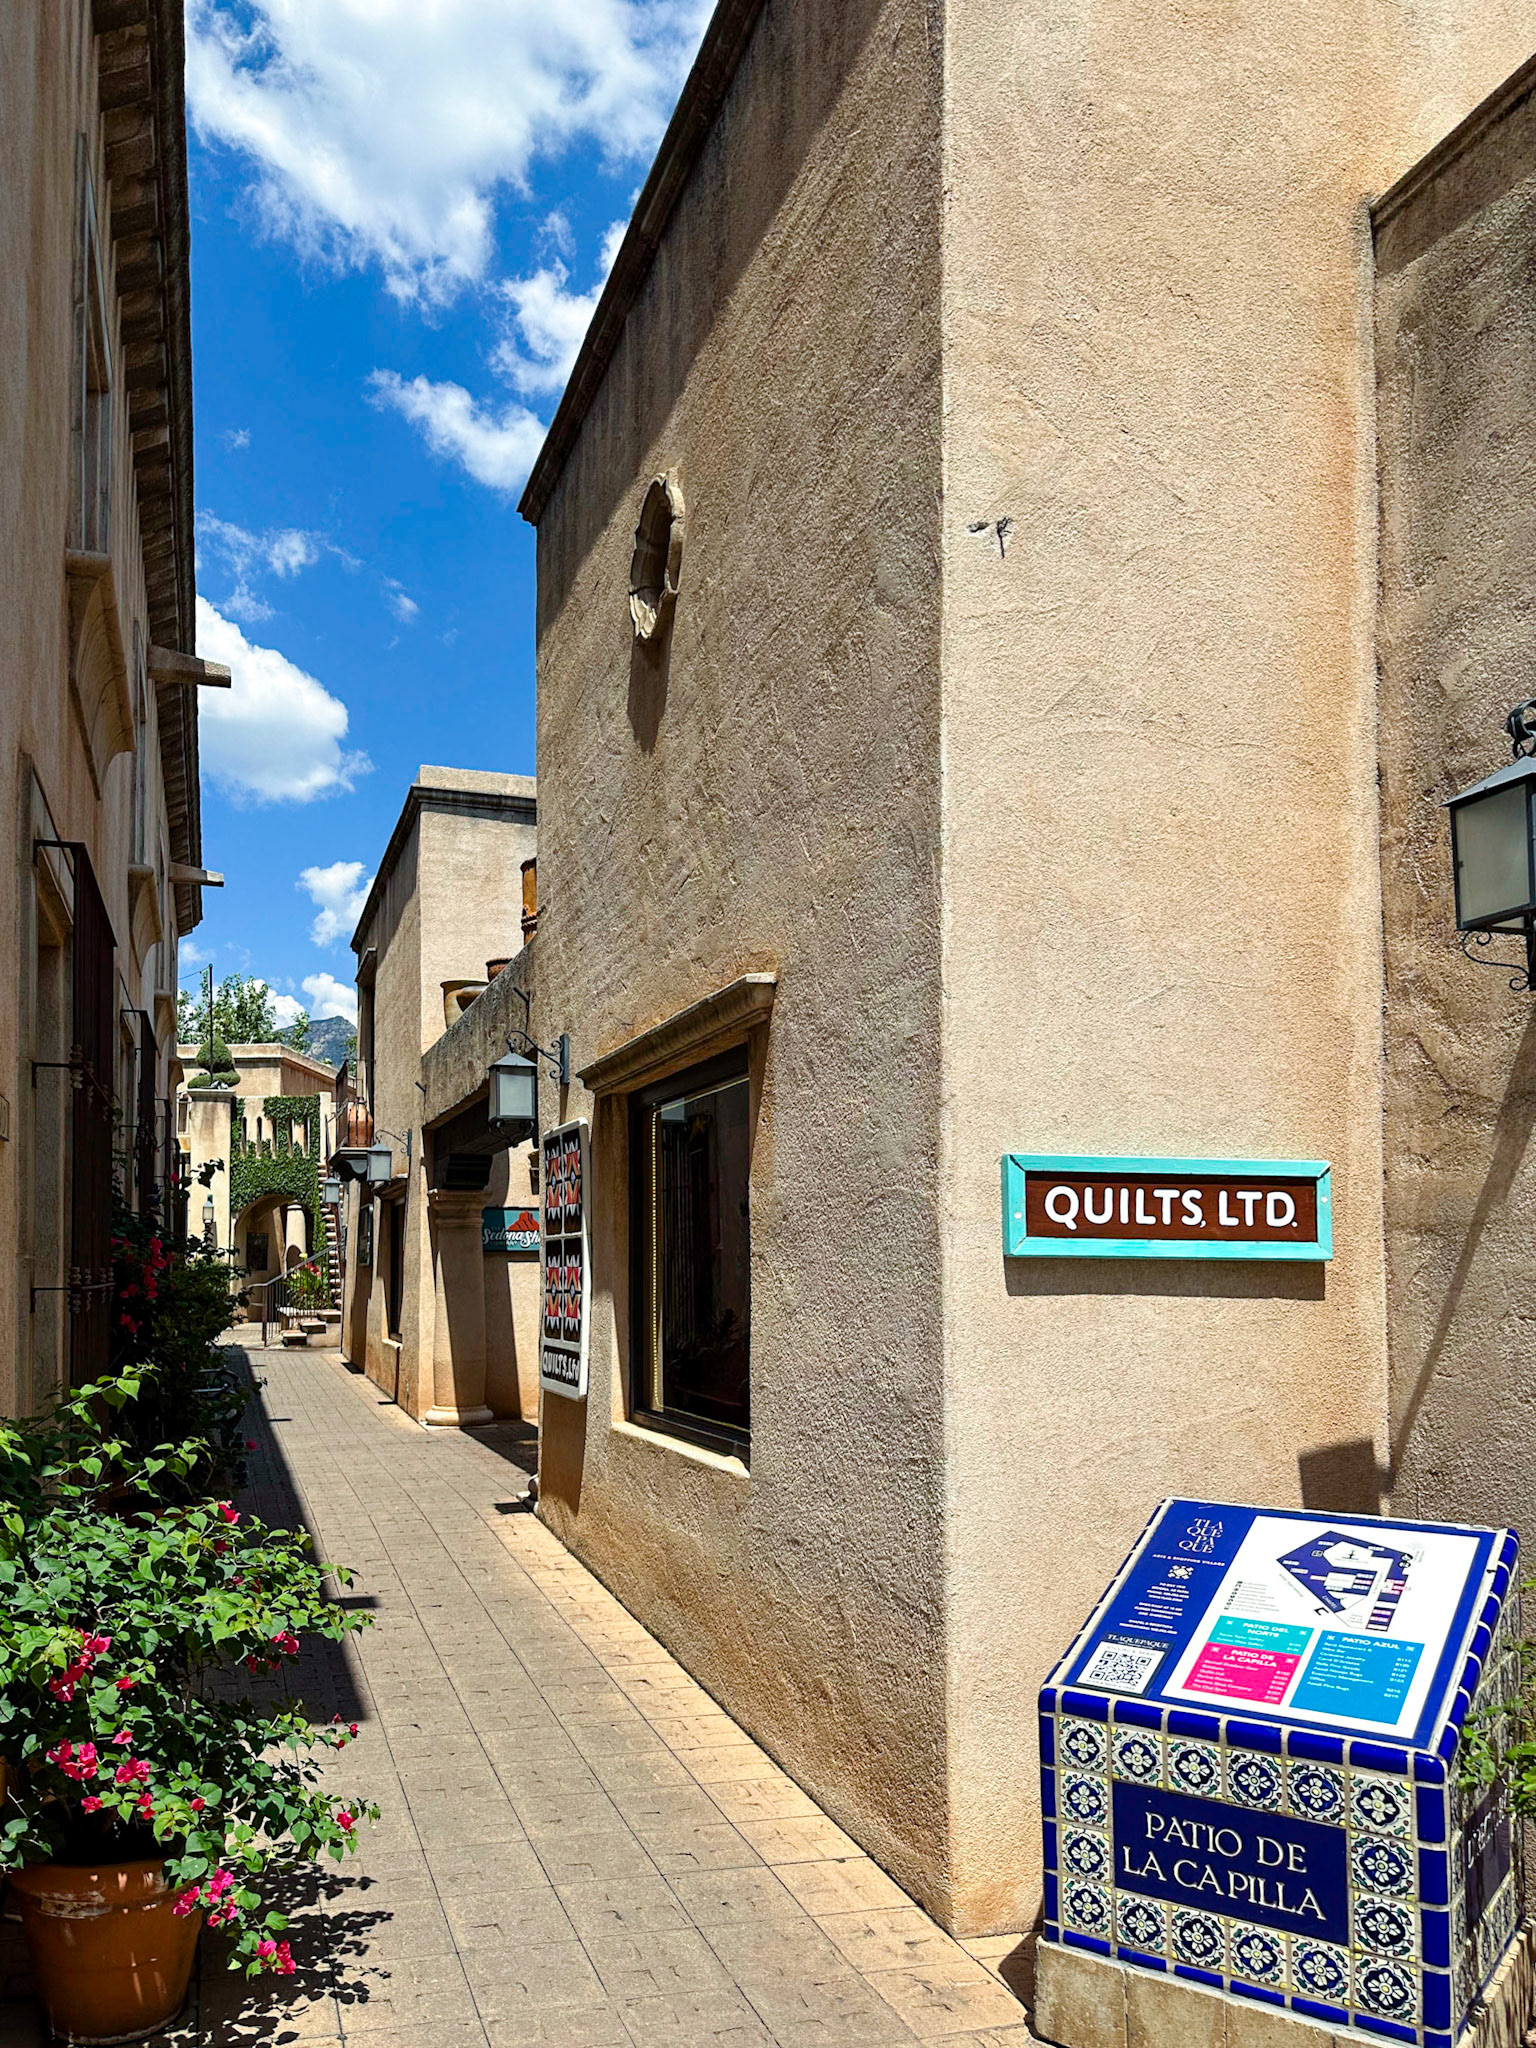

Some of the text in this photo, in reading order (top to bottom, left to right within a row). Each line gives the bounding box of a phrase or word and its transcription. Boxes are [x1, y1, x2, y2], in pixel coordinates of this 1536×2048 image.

[1044, 1185, 1298, 1230] QUILTS, LTD.
[483, 1226, 541, 1248] Sedona Sh
[1194, 1518, 1223, 1530] TLA
[1187, 1527, 1224, 1537] QUE
[1179, 1540, 1214, 1553] QUE
[1196, 1536, 1214, 1546] PA
[1247, 1629, 1279, 1637] NORTE
[1107, 1633, 1169, 1649] TLAQUEPAQUE
[1373, 1641, 1401, 1649] AZUL
[1231, 1649, 1258, 1657] PATIO
[1237, 1656, 1277, 1666] CAPILLA
[1145, 1811, 1308, 1874] PATIO DE
[1122, 1845, 1327, 1921] LA CAPILLA
